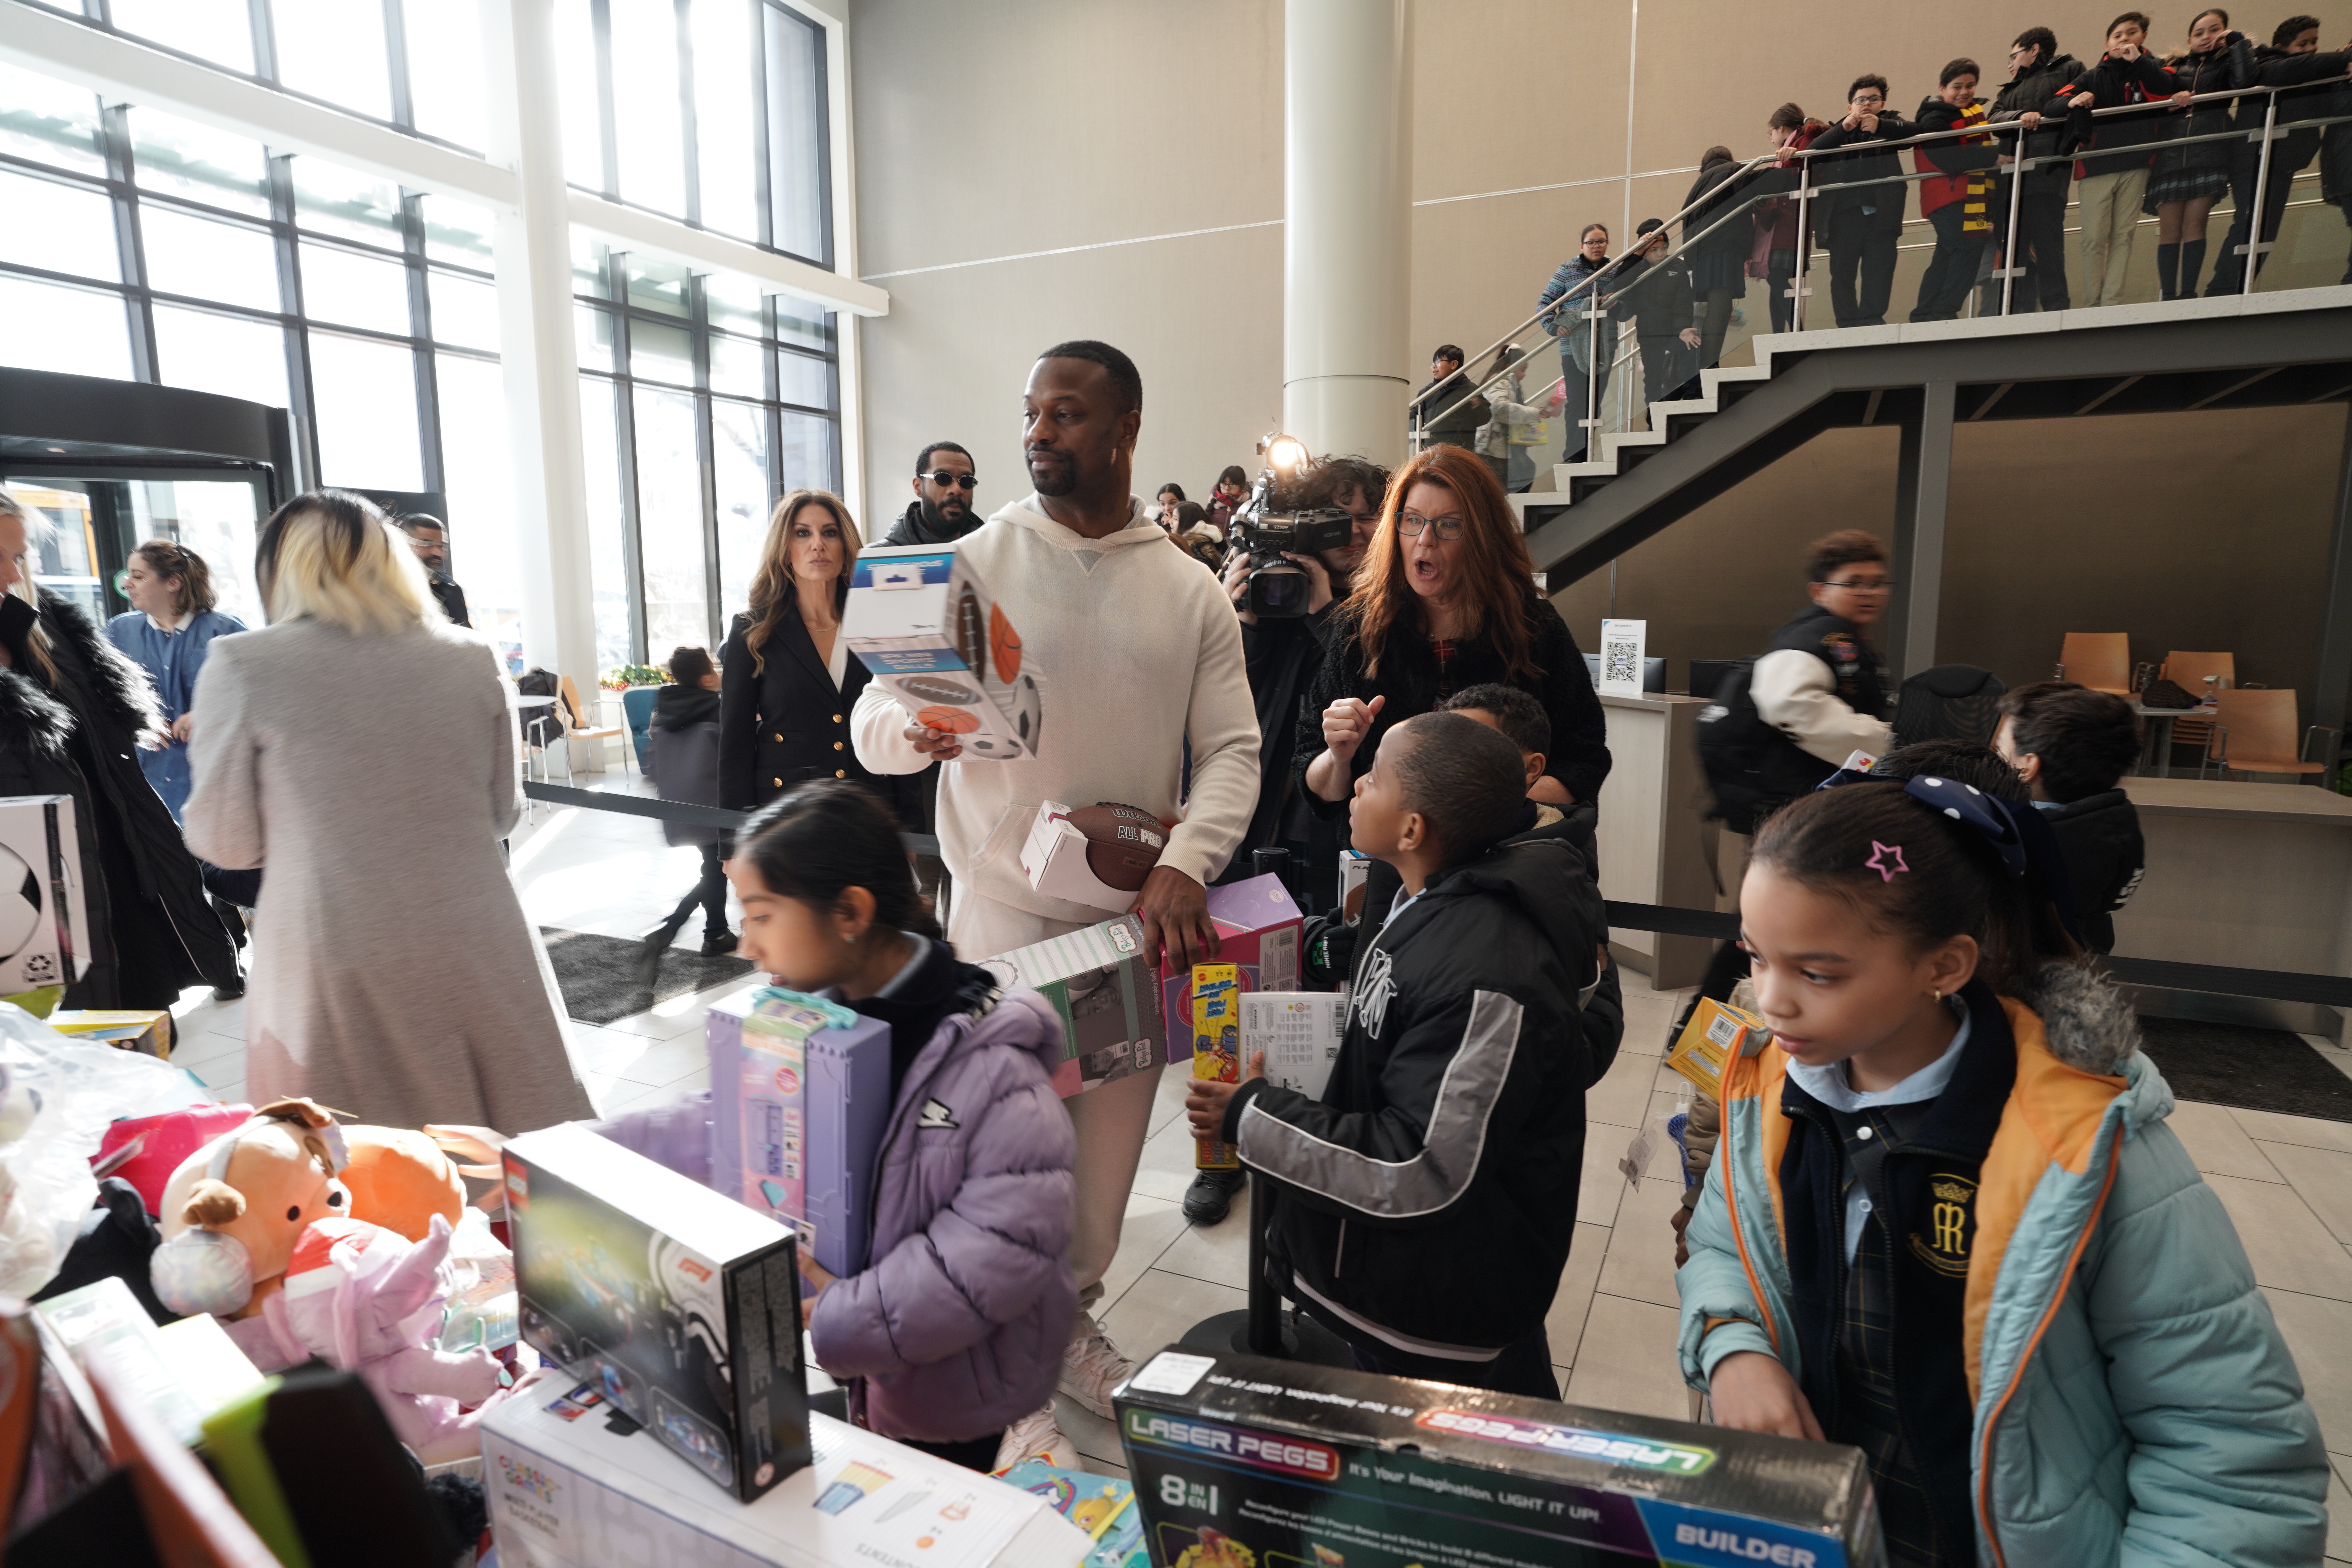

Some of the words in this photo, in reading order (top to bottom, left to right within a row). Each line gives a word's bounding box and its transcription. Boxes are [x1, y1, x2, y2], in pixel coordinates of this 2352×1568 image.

[1110, 808, 1161, 828] Wilson
[1118, 825, 1139, 841] ALL
[1140, 828, 1162, 849] PRO
[1113, 926, 1127, 937] First
[1121, 933, 1137, 953] Baby's
[1322, 936, 1331, 968] MINECRAFT
[1131, 1413, 1232, 1453] LASER
[1238, 1435, 1329, 1471] PEGS
[1427, 1409, 1536, 1446] PEGS
[1540, 1427, 1703, 1470] LASER
[1160, 1473, 1187, 1507] 8
[1190, 1482, 1205, 1495] IN
[1188, 1496, 1207, 1510] EN
[1349, 1462, 1370, 1478] It's
[1374, 1466, 1406, 1484] Your
[1498, 1491, 1543, 1512] LIGHT
[1548, 1503, 1563, 1516] IT
[1328, 1517, 1352, 1530] Power
[1382, 1532, 1398, 1542] and
[1675, 1522, 1817, 1568] BUILDER
